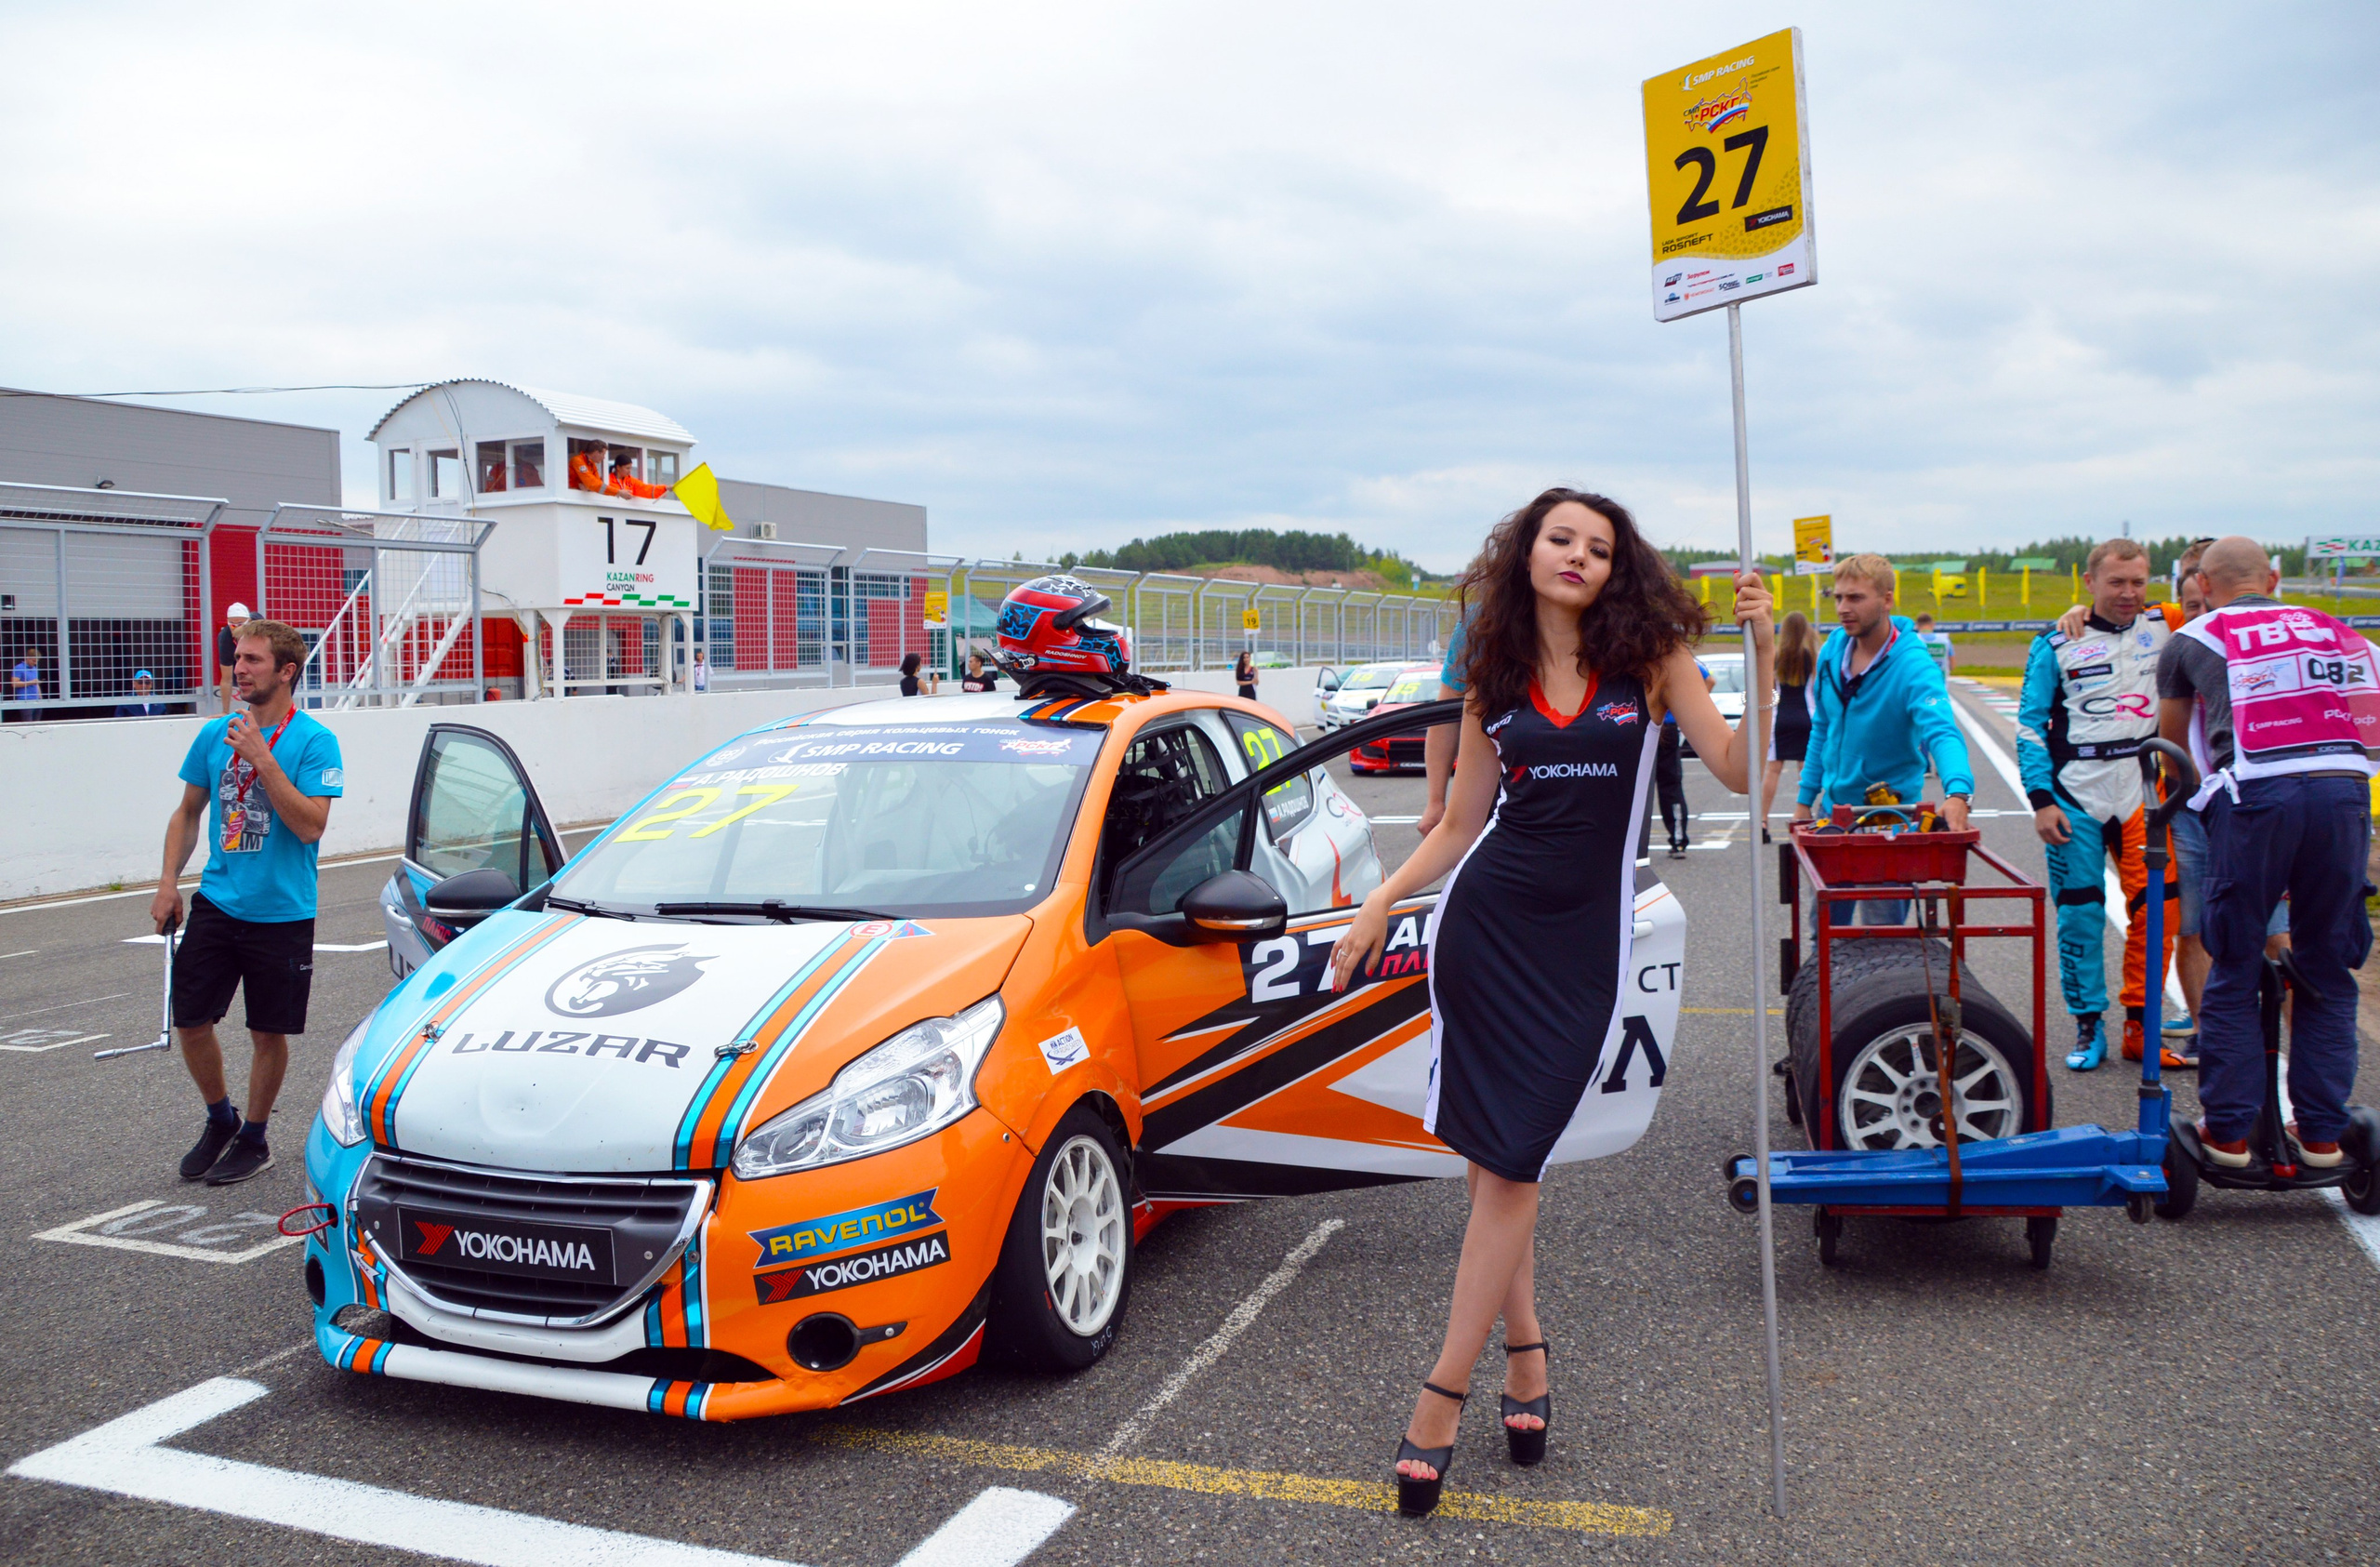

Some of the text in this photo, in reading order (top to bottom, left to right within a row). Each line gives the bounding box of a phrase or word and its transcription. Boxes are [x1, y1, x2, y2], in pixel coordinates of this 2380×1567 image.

[1693, 55, 1754, 86] SMP RACING
[1673, 125, 1769, 226] 27
[1756, 210, 1790, 226] YOKOHAMA
[1662, 233, 1713, 254] ROSNEFT
[597, 516, 656, 565] 17
[606, 572, 654, 583] KAZANRING
[606, 583, 635, 591] CANYON
[1045, 649, 1087, 659] RADOSHNOV
[2308, 657, 2366, 684] 082
[972, 727, 1021, 736] гонок
[800, 741, 964, 758] SMP RACING
[1528, 763, 1618, 779] YOKOHAMA
[613, 784, 800, 843] 27
[452, 1030, 691, 1069] LUZAR
[1056, 1033, 1074, 1047] ACTION
[769, 1203, 927, 1255] RAVENOL
[454, 1229, 596, 1270] YOKOHAMA
[805, 1239, 946, 1290] YOKOHAMA
